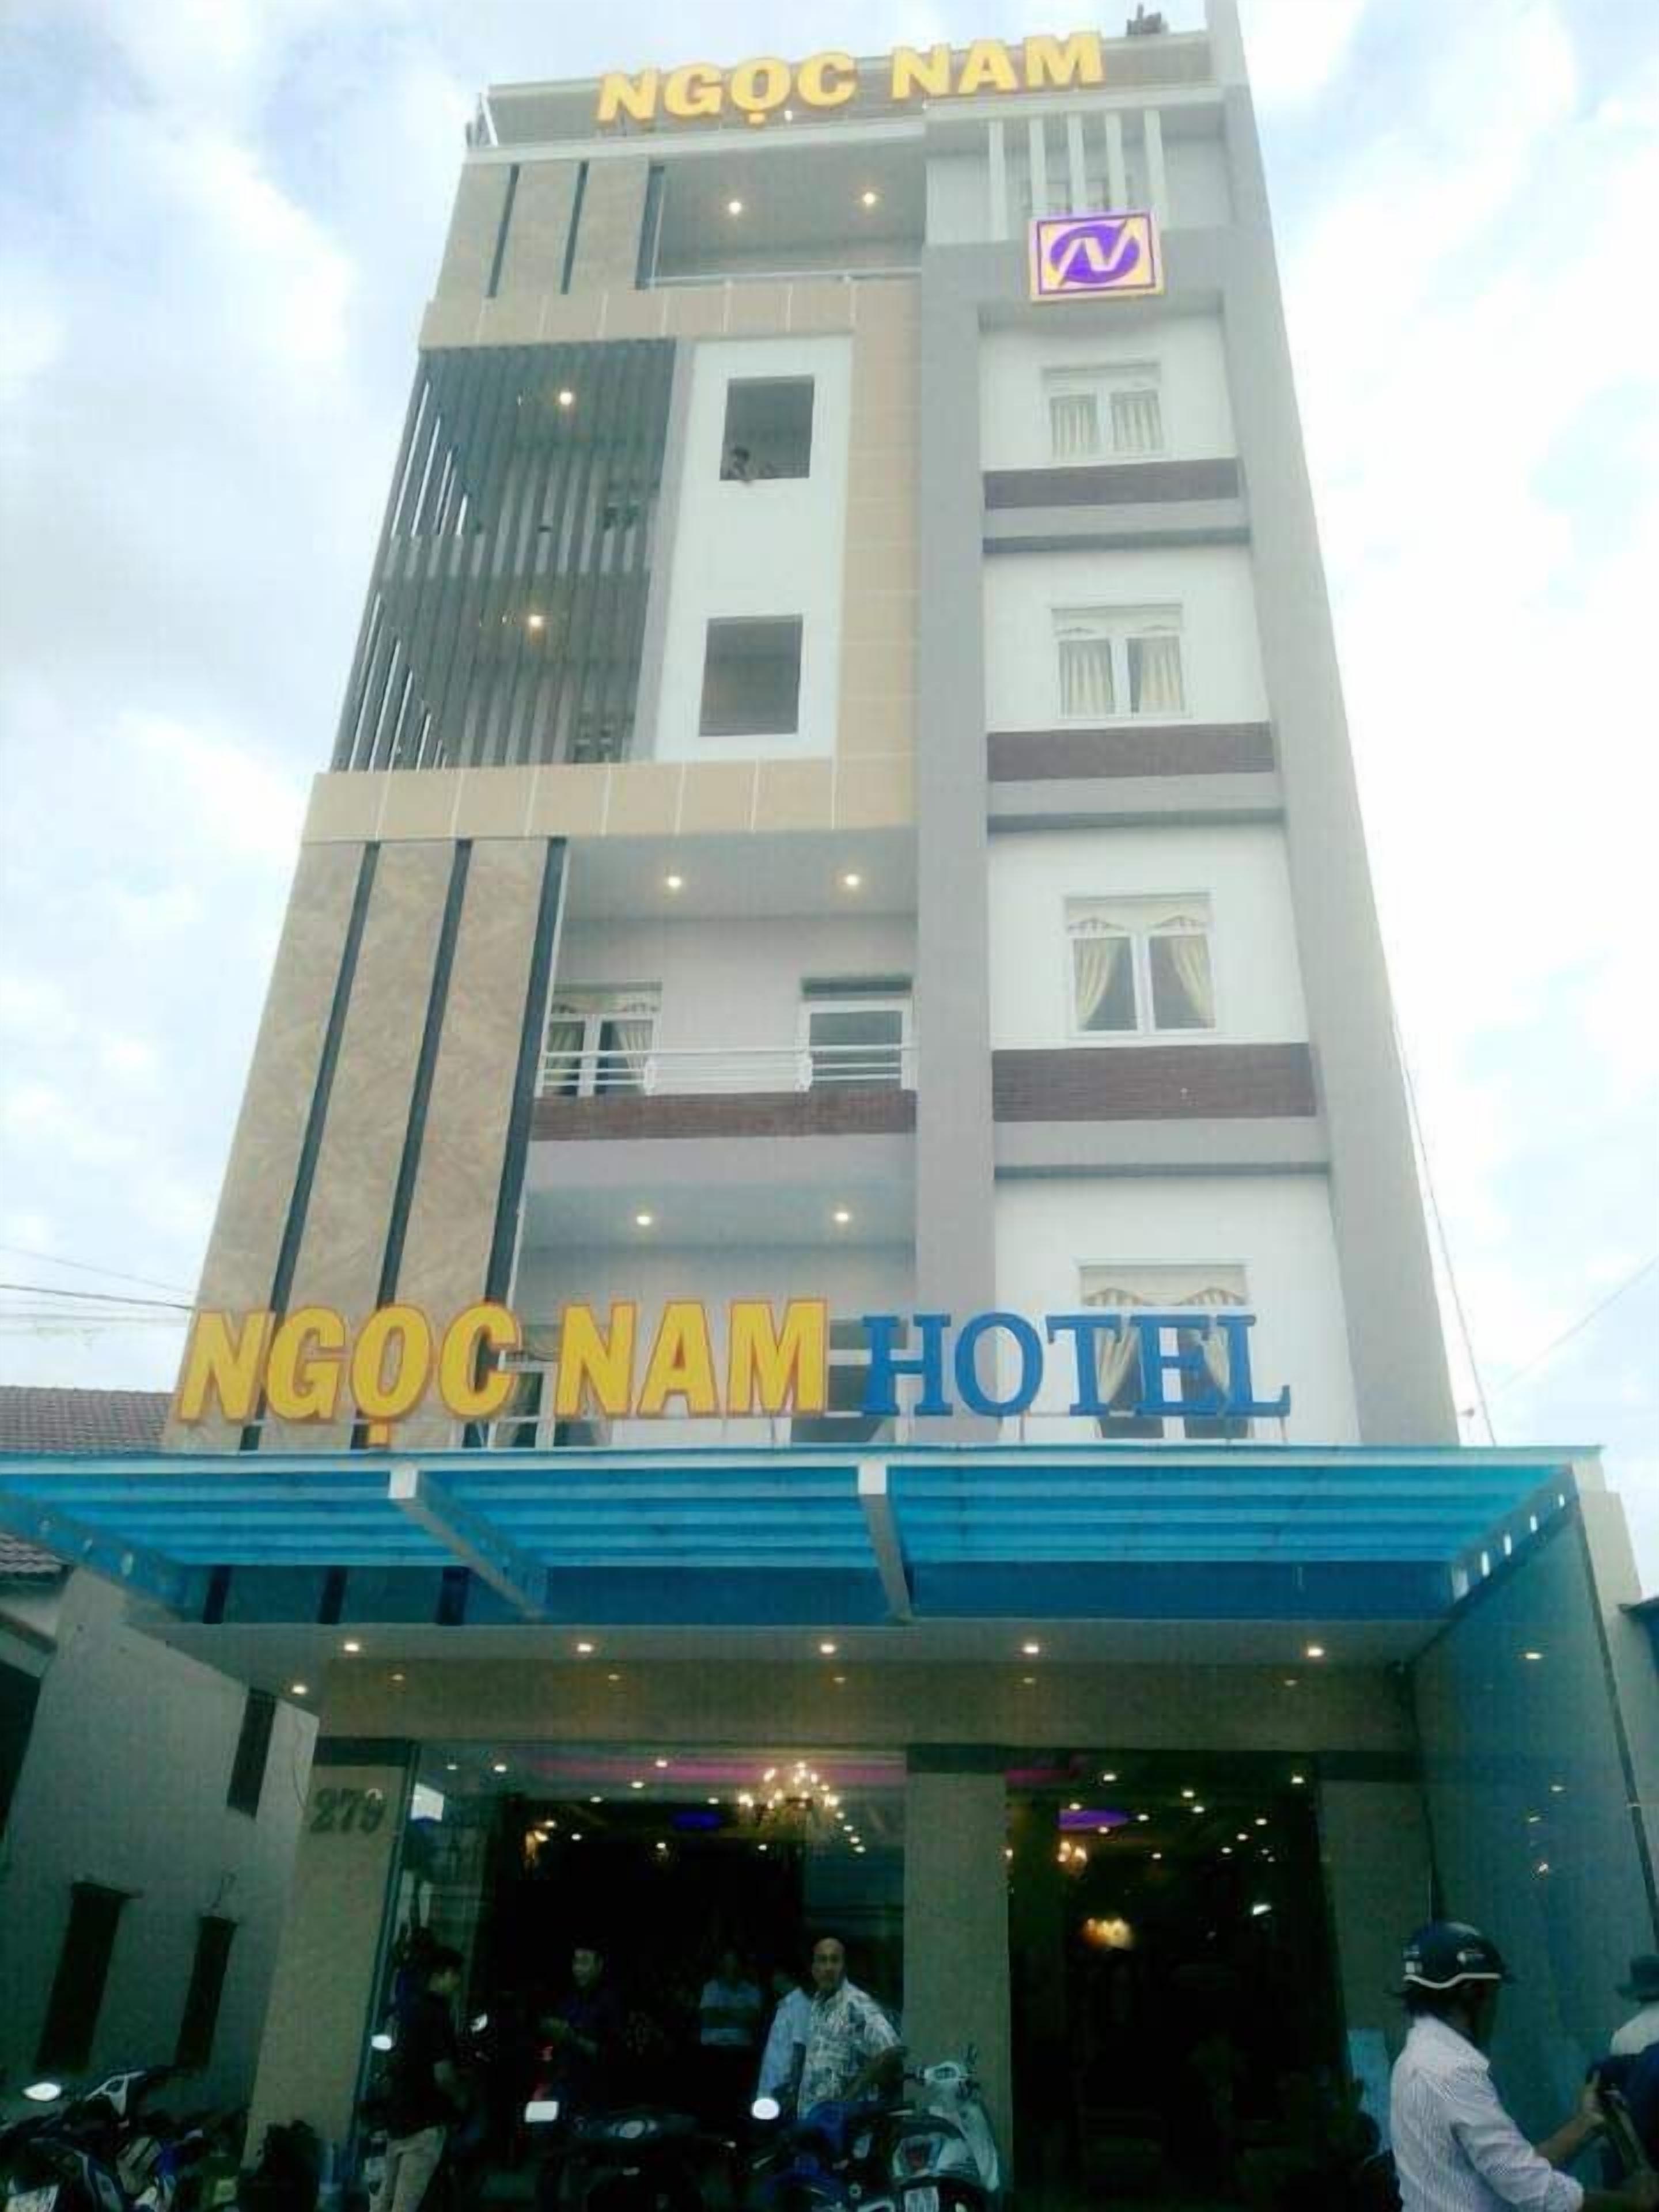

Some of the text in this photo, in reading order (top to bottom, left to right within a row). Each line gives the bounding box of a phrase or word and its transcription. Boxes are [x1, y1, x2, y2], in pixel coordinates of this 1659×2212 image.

[597, 32, 1105, 122] NGỌC NAM
[178, 1299, 1291, 1446] NGỌC NAM HOTEL
